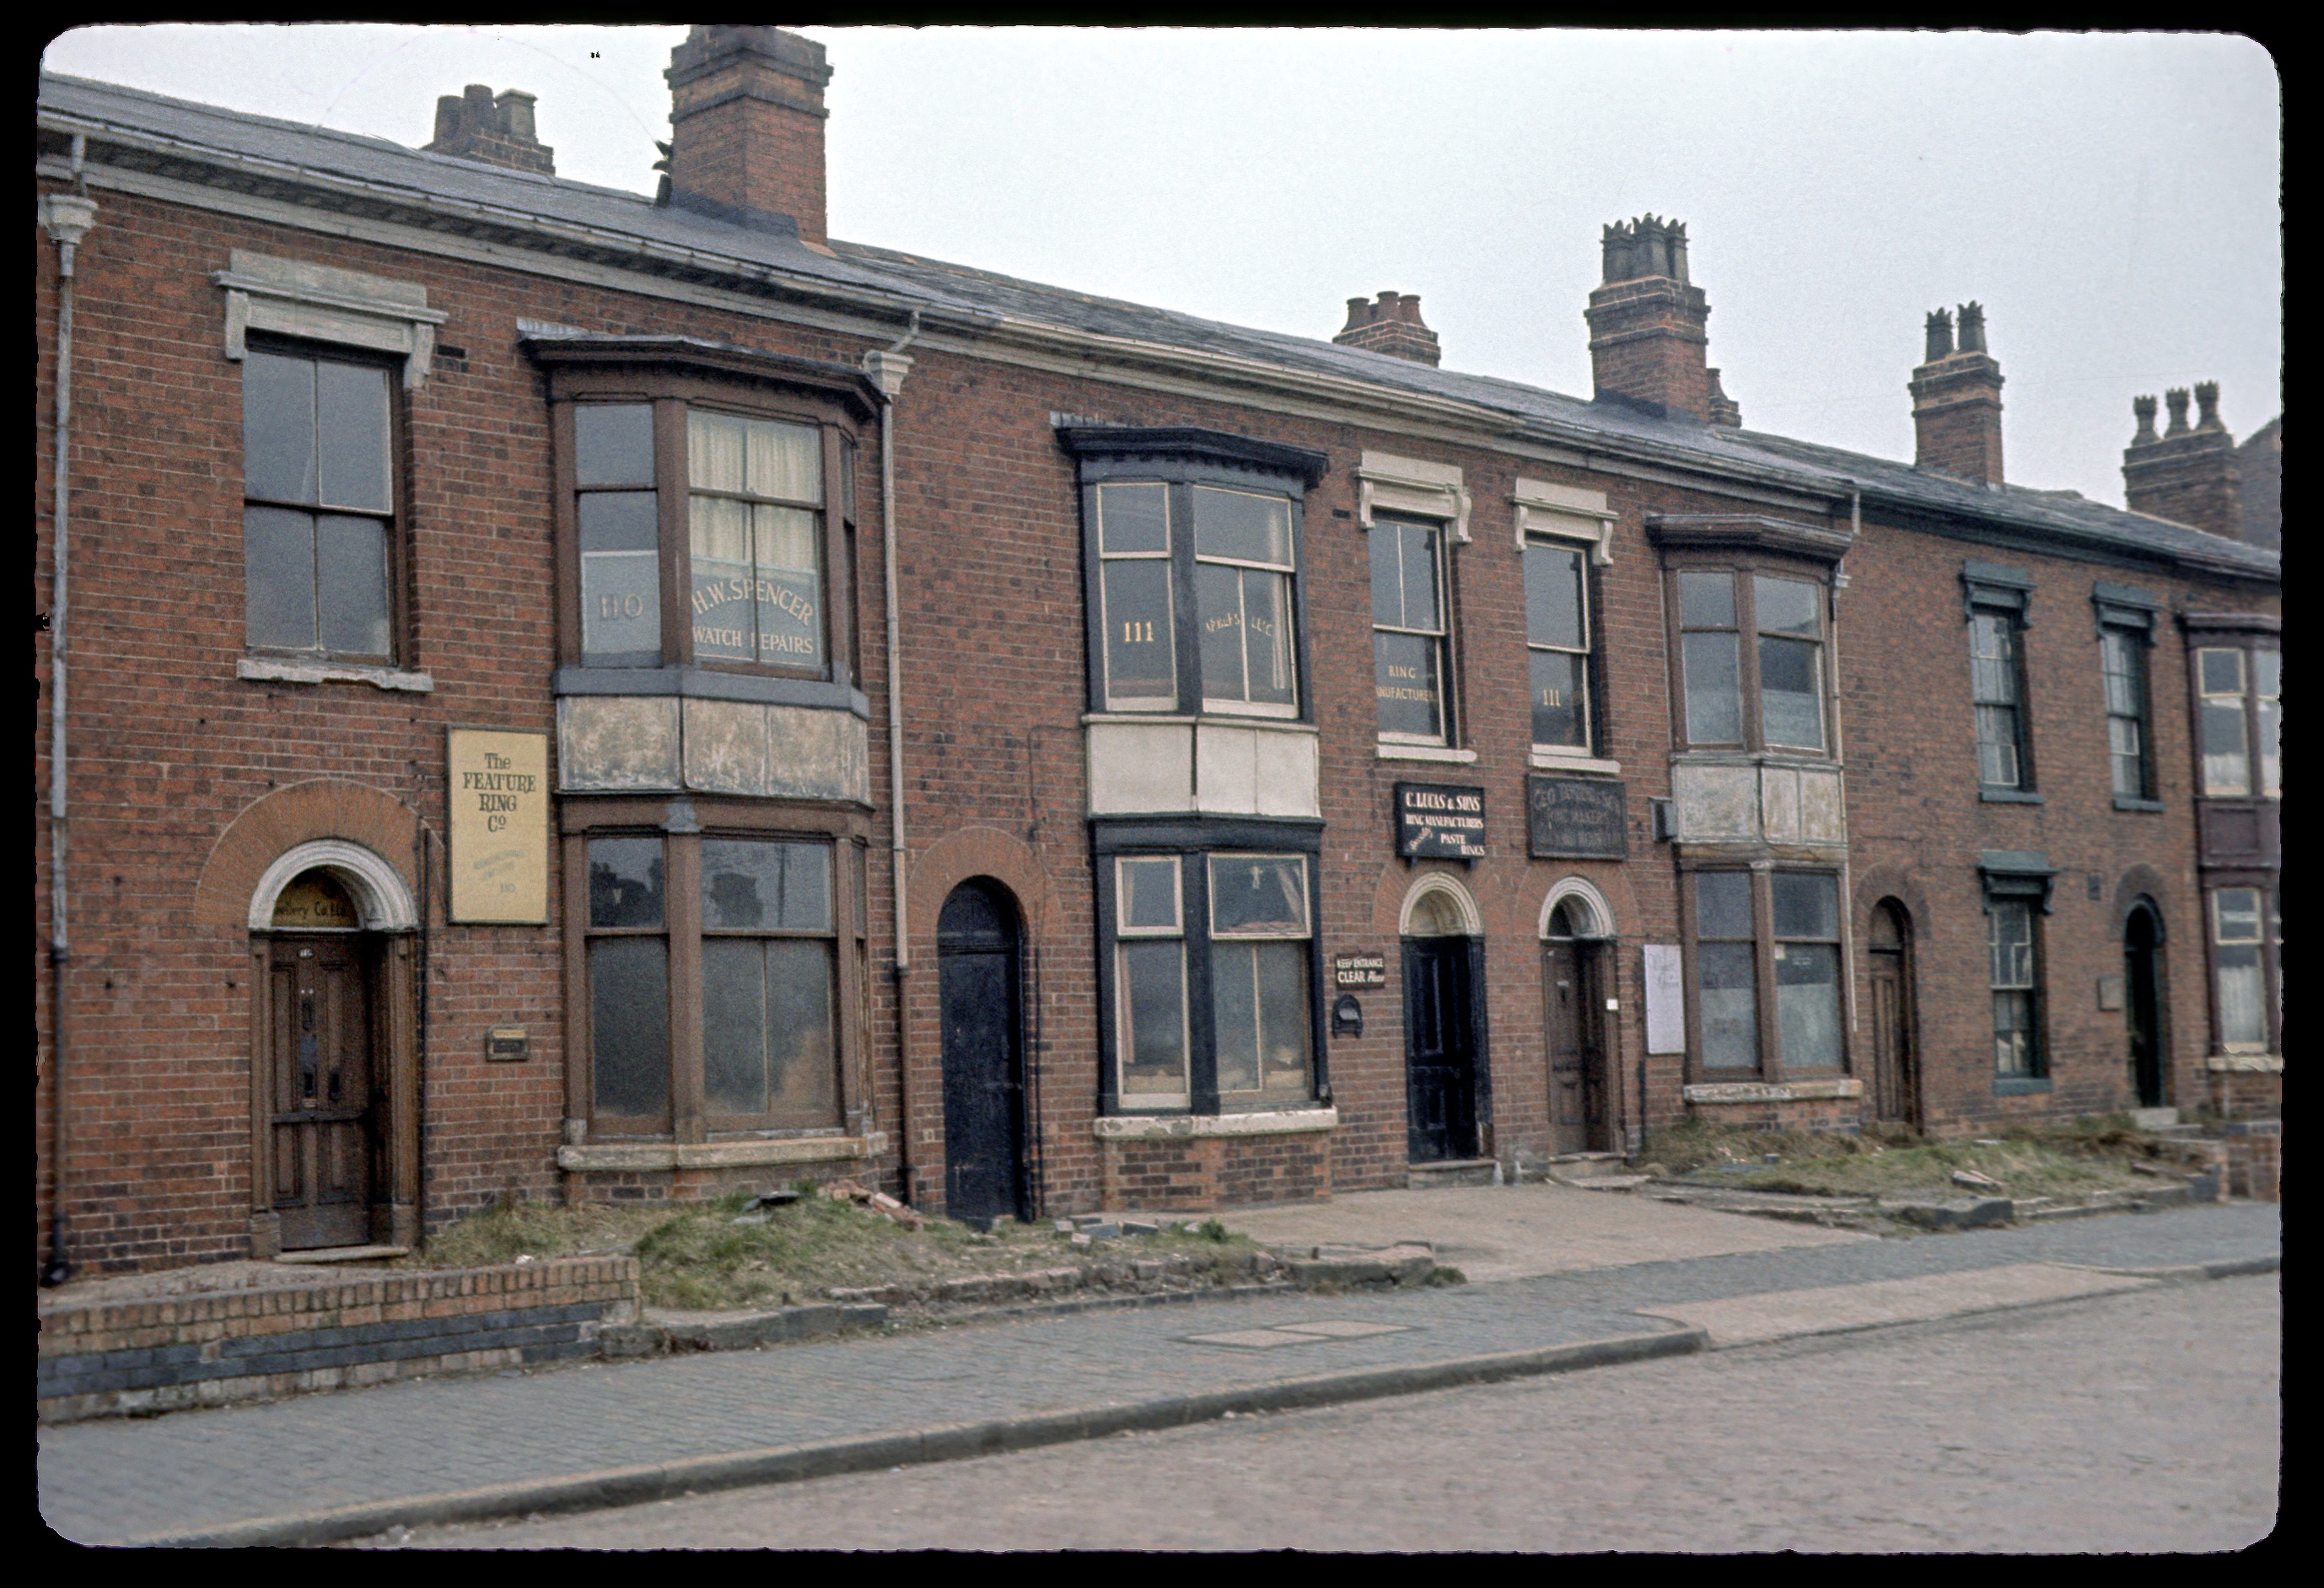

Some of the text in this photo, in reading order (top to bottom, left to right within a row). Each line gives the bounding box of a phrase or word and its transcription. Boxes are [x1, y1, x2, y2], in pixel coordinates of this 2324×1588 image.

[600, 593, 643, 618] 110
[692, 626, 742, 648] WATCH
[1124, 621, 1154, 643] 111
[1543, 688, 1562, 706] 111
[484, 752, 511, 770] The
[463, 772, 536, 794] FEATURE
[478, 794, 517, 813] RING
[1447, 798, 1455, 810] &
[1456, 795, 1481, 811] SONS
[1440, 833, 1466, 845] PASTE
[1461, 844, 1485, 856] RINGS
[1353, 958, 1384, 968] ENTRANCE
[1337, 970, 1366, 983] CLEAR
